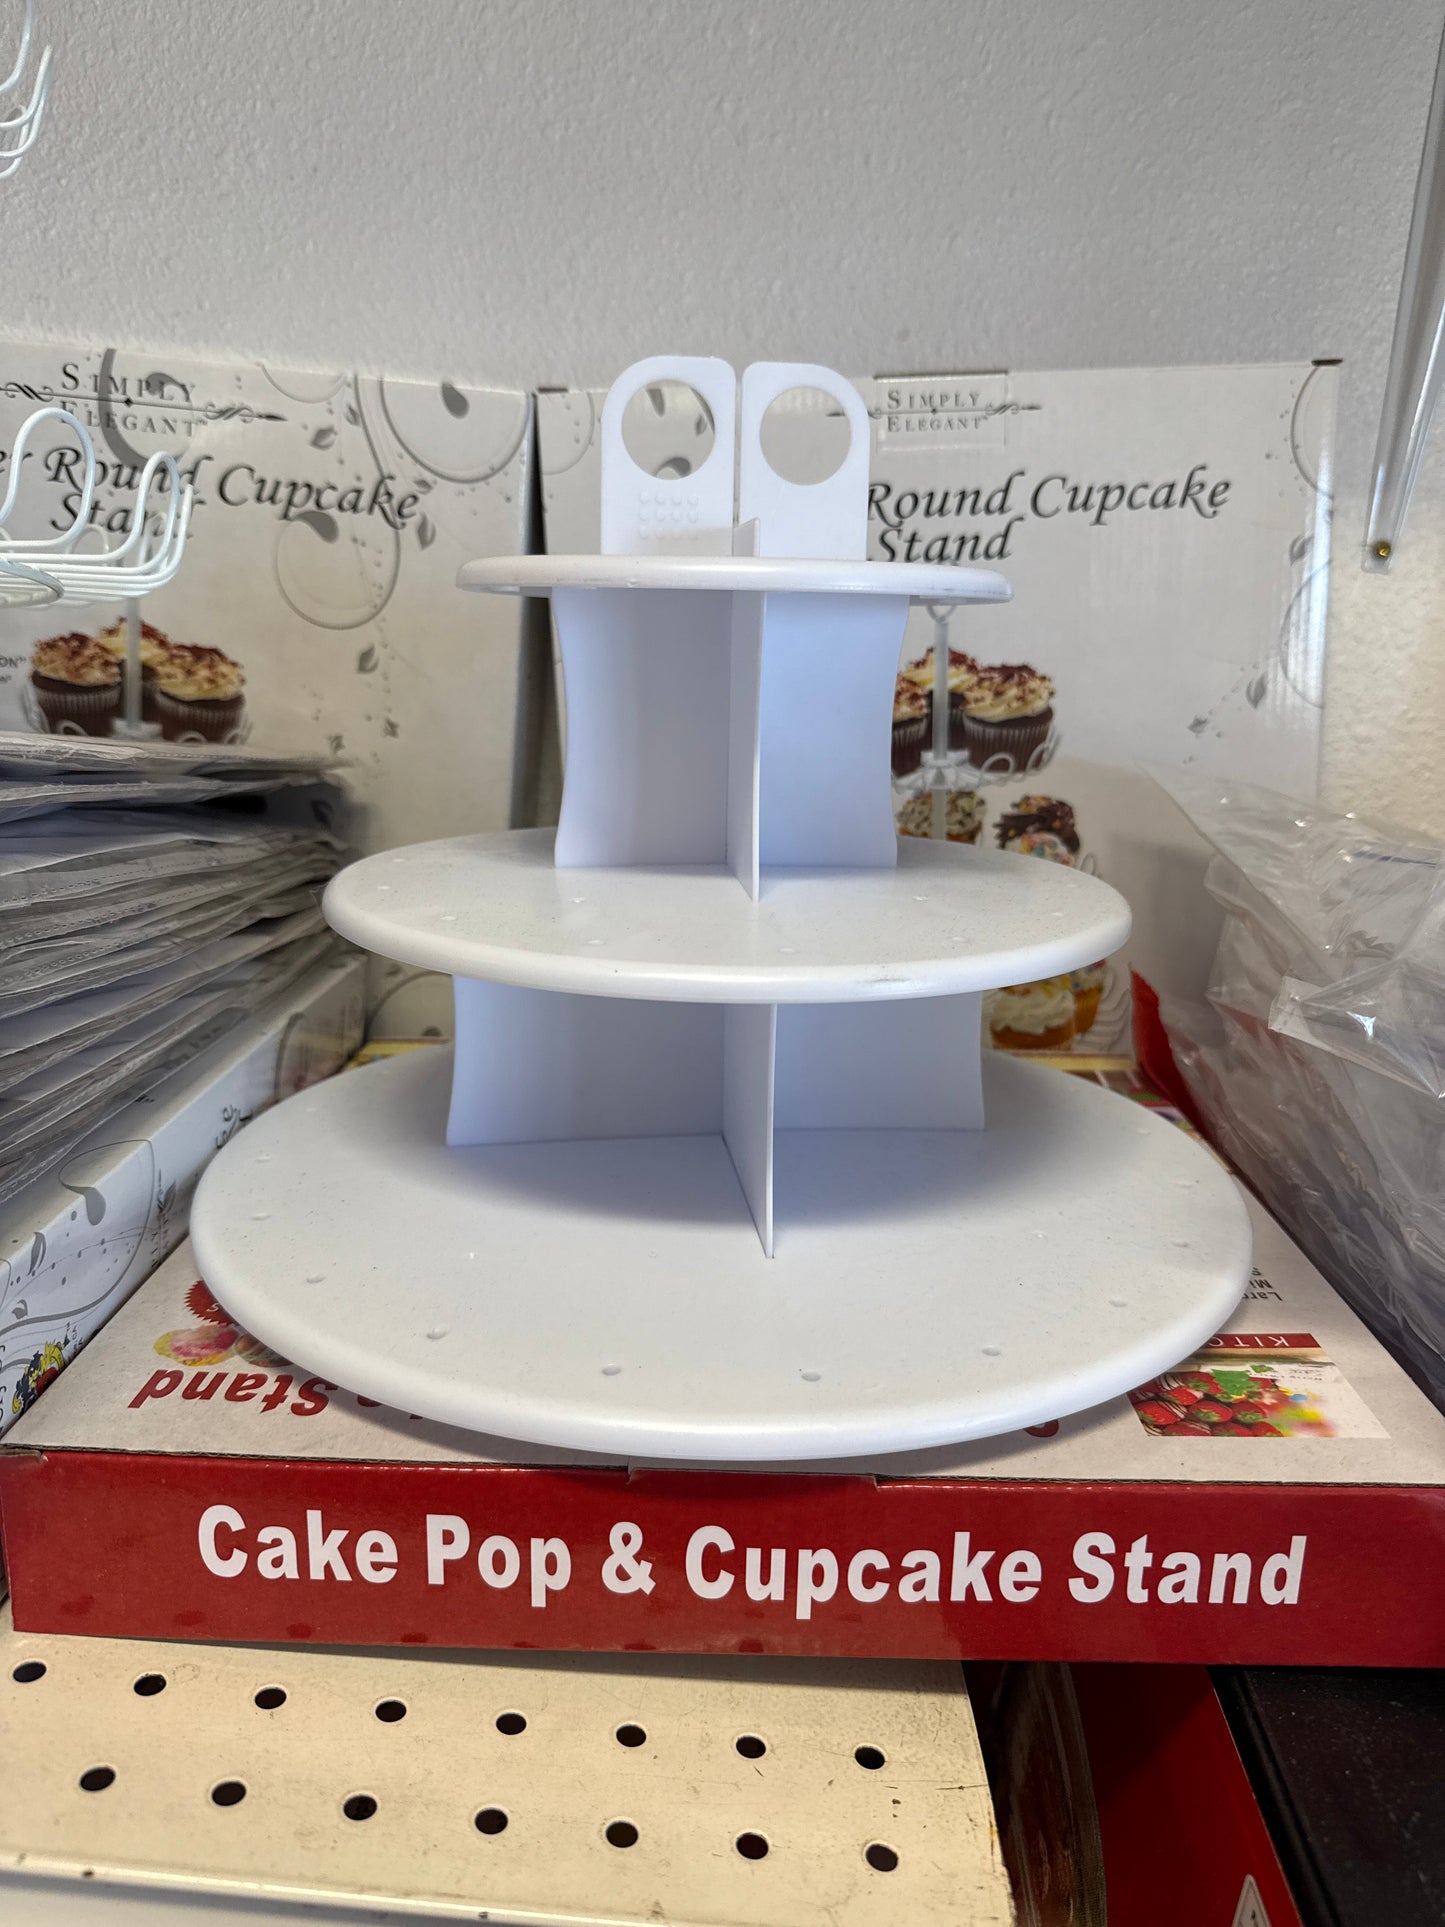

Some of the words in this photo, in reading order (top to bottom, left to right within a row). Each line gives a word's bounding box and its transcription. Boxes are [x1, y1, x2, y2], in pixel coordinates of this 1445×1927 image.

[886, 388, 981, 410] SIMPLY
[218, 464, 420, 530] Cupcake
[867, 469, 1025, 528] Round
[1030, 463, 1231, 526] Cupcake
[867, 514, 1025, 564] Stand
[128, 1369, 338, 1416] Stand
[198, 1505, 400, 1585] Cake
[426, 1514, 572, 1608] Pop
[601, 1521, 657, 1595] &
[685, 1525, 1042, 1620] Cupcake
[1068, 1531, 1308, 1607] Stand
